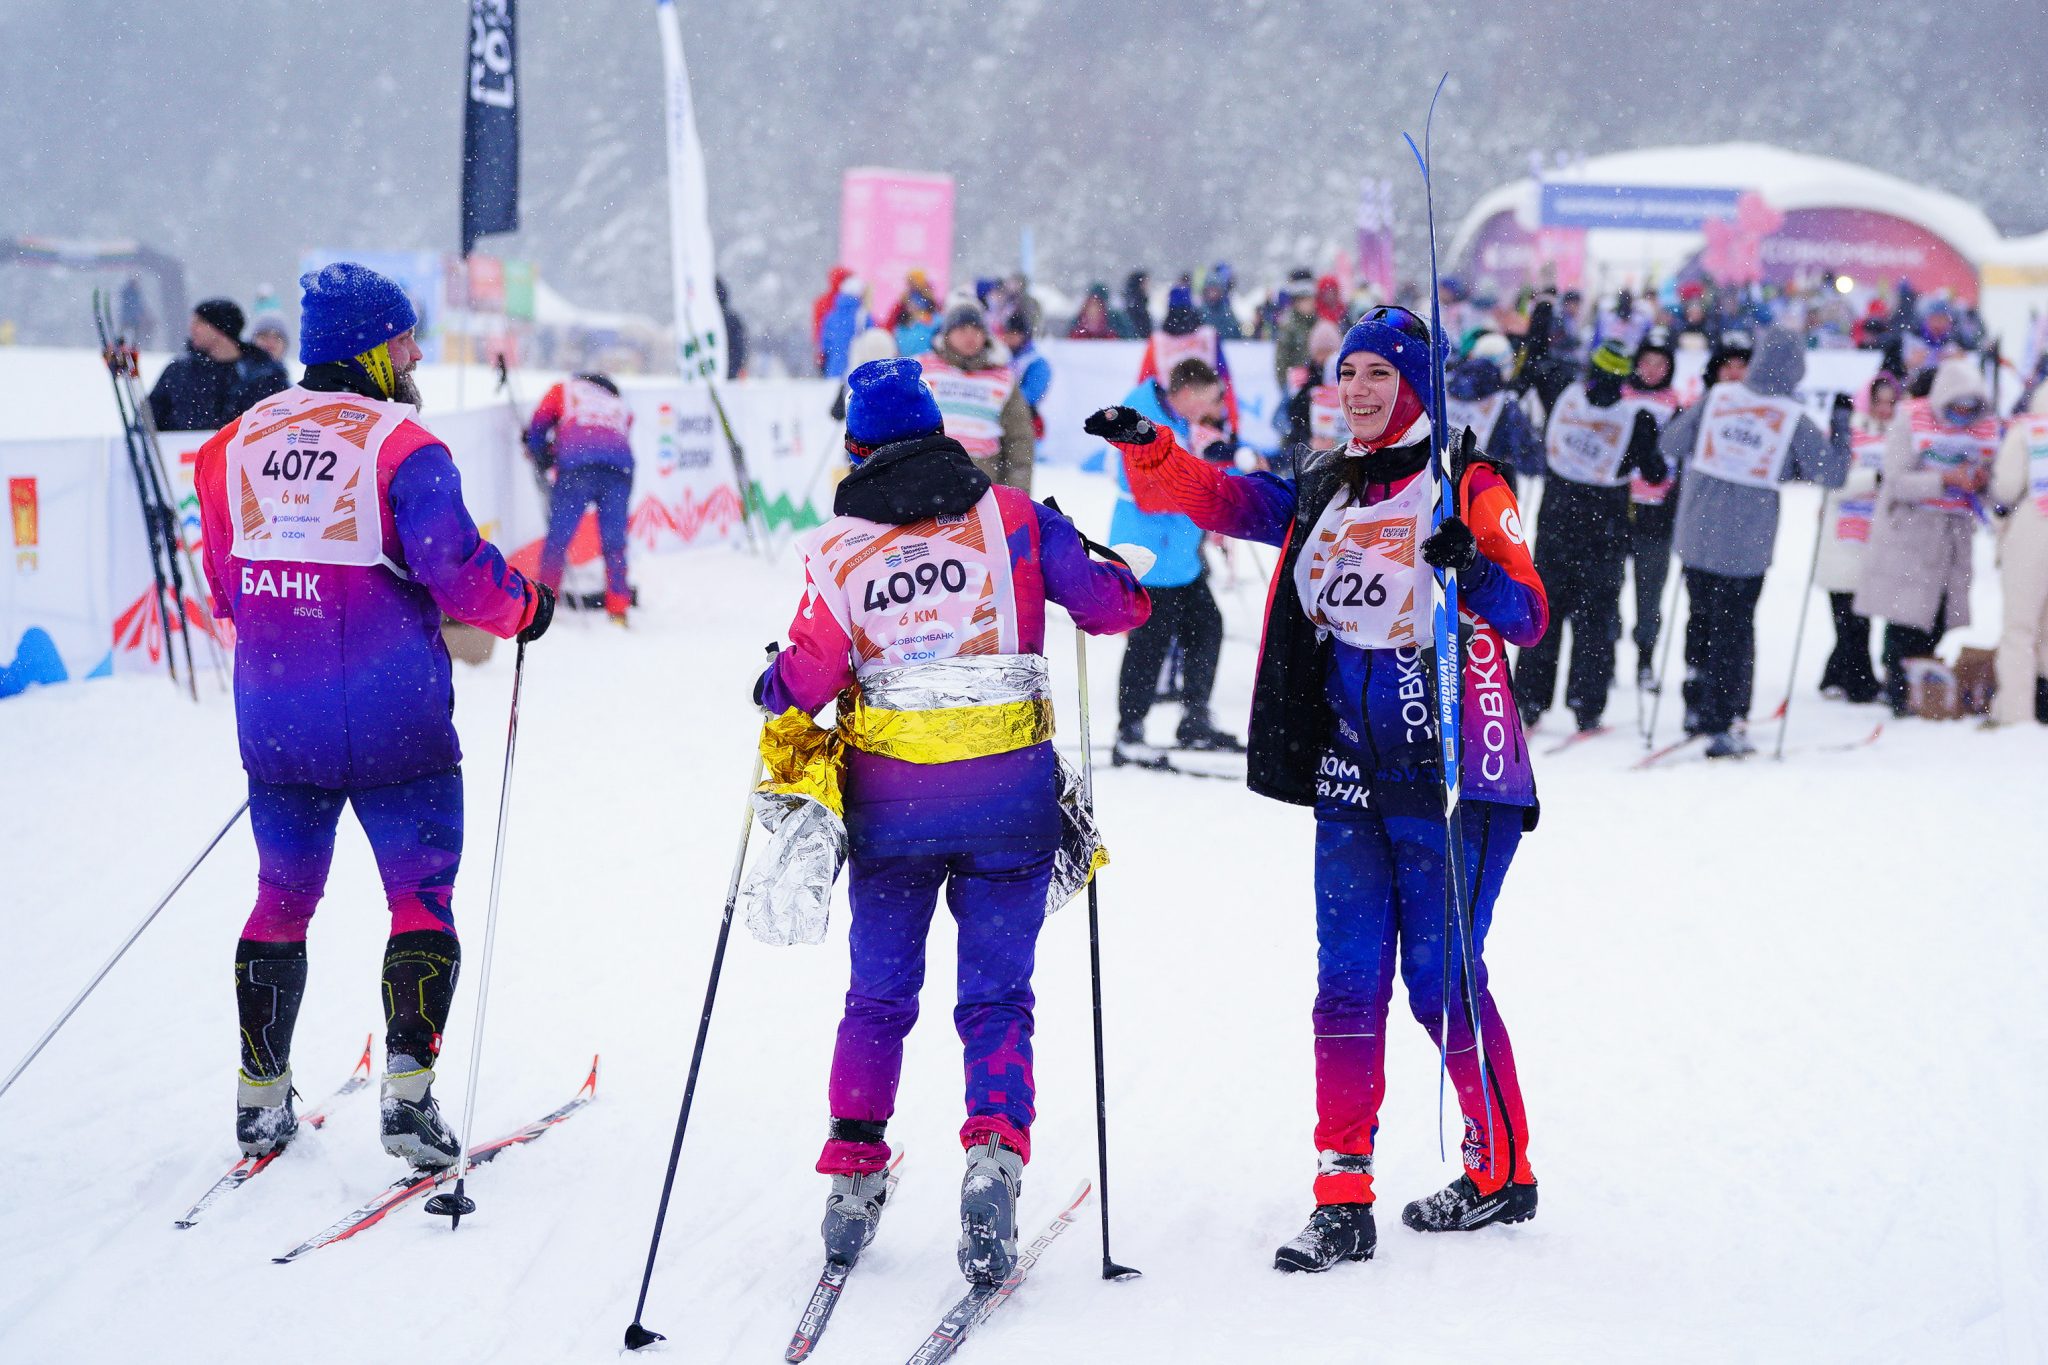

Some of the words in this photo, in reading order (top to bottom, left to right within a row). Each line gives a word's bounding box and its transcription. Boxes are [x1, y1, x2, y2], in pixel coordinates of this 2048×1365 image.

[262, 449, 338, 481] 4072
[281, 490, 290, 504] 6
[294, 493, 310, 505] КМ
[281, 531, 306, 539] OZON
[847, 546, 877, 568] 14.02.2026
[241, 567, 322, 602] БАНК
[863, 558, 967, 613] 4090
[898, 612, 909, 626] 6
[914, 609, 938, 624] КМ
[903, 650, 936, 661] OZON
[1439, 656, 1453, 725] NORDWAY
[1461, 1198, 1498, 1219] NORDWAY
[798, 1286, 832, 1337] SPORT
